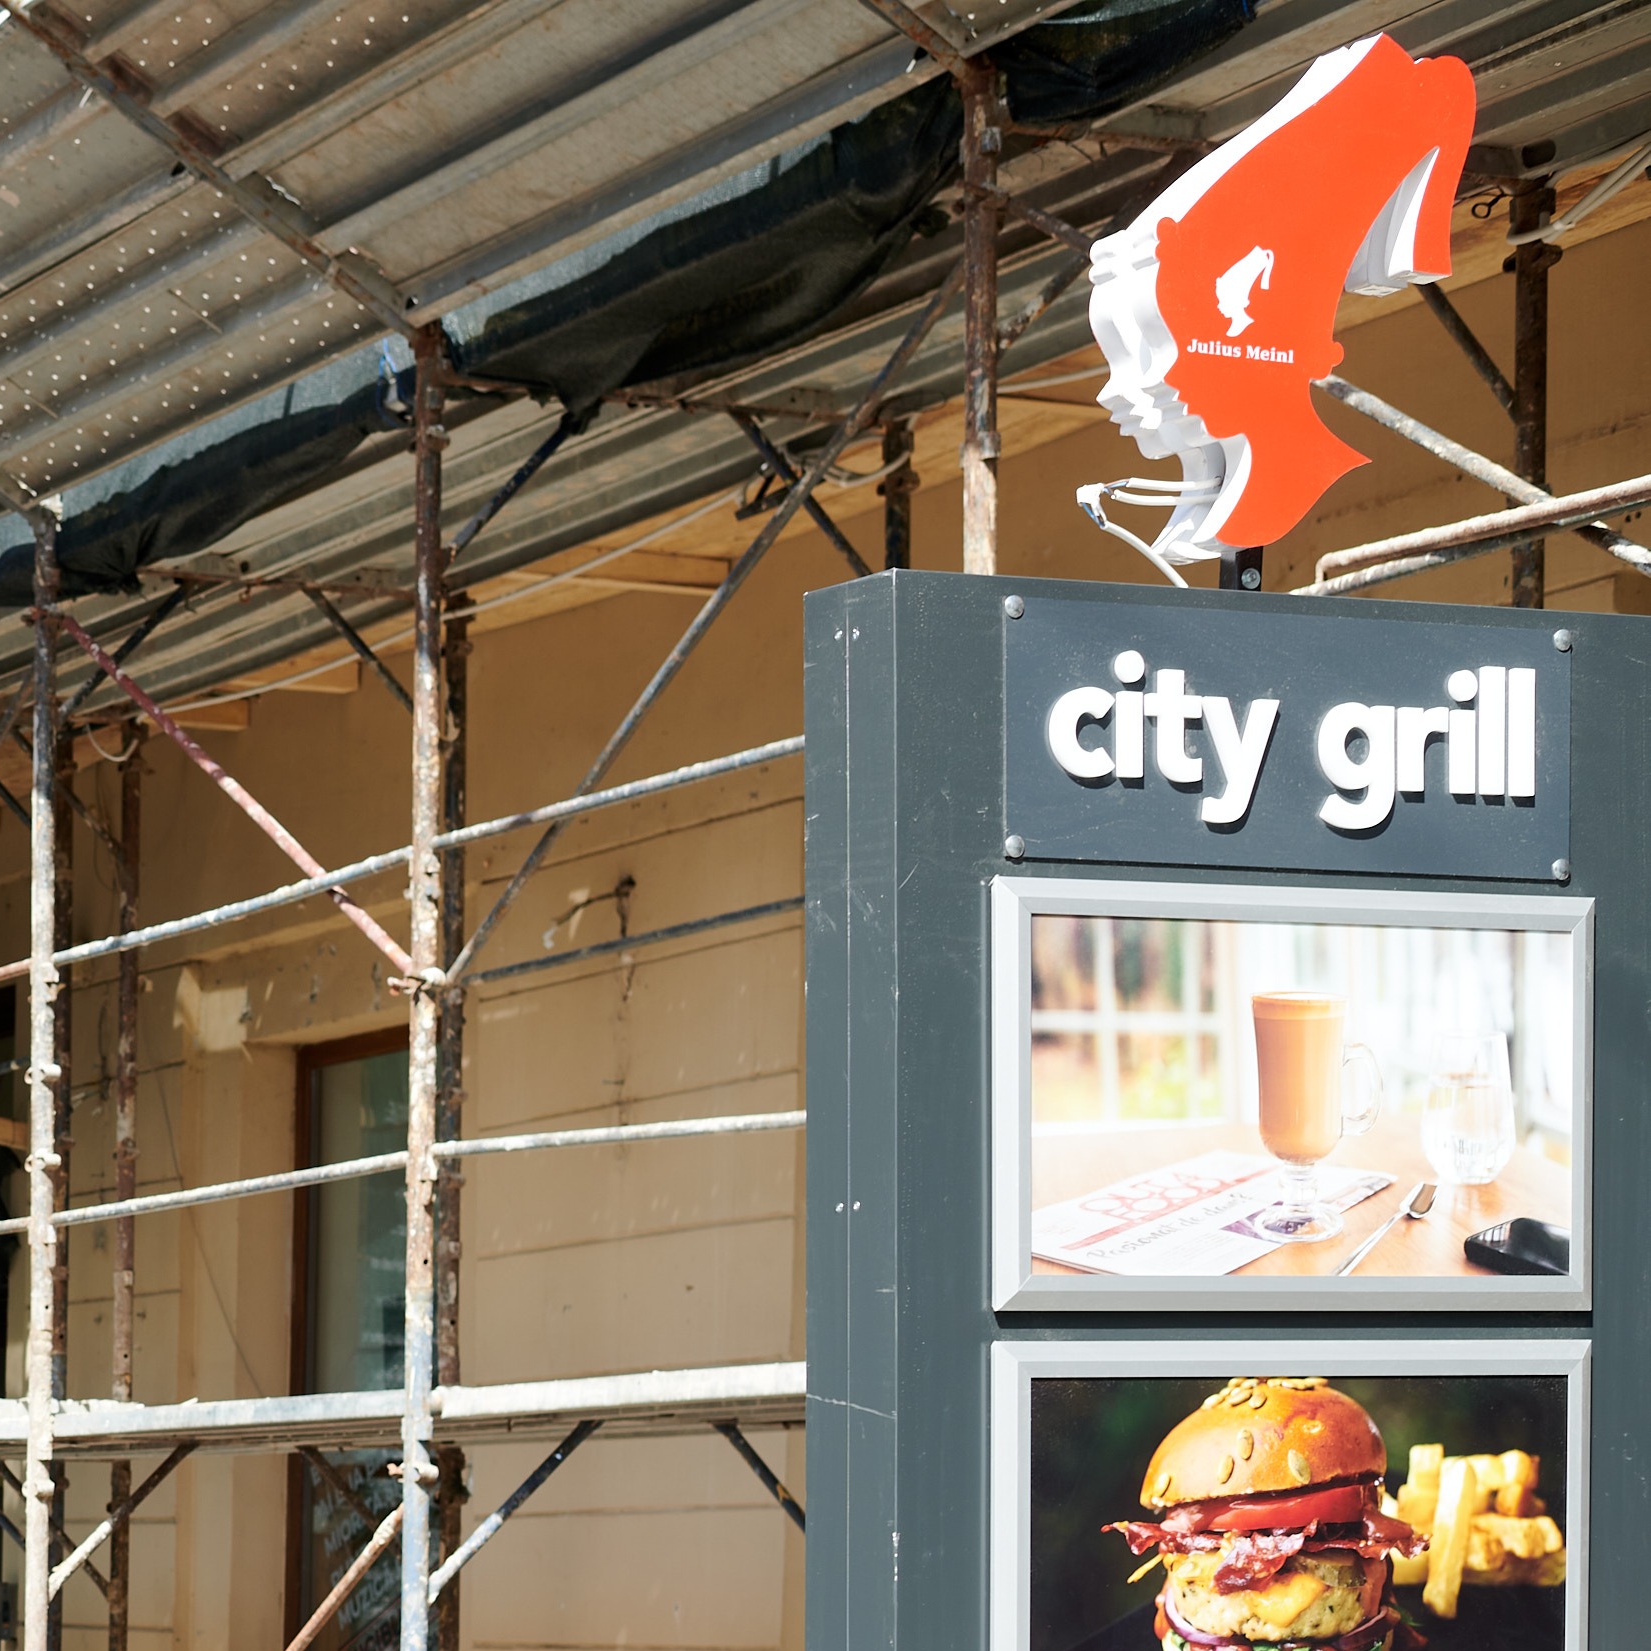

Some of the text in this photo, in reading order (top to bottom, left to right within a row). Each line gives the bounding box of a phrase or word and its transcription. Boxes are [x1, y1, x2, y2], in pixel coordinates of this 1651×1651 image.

[1187, 339, 1294, 364] Julius Meinl
[1048, 650, 1536, 829] city grill
